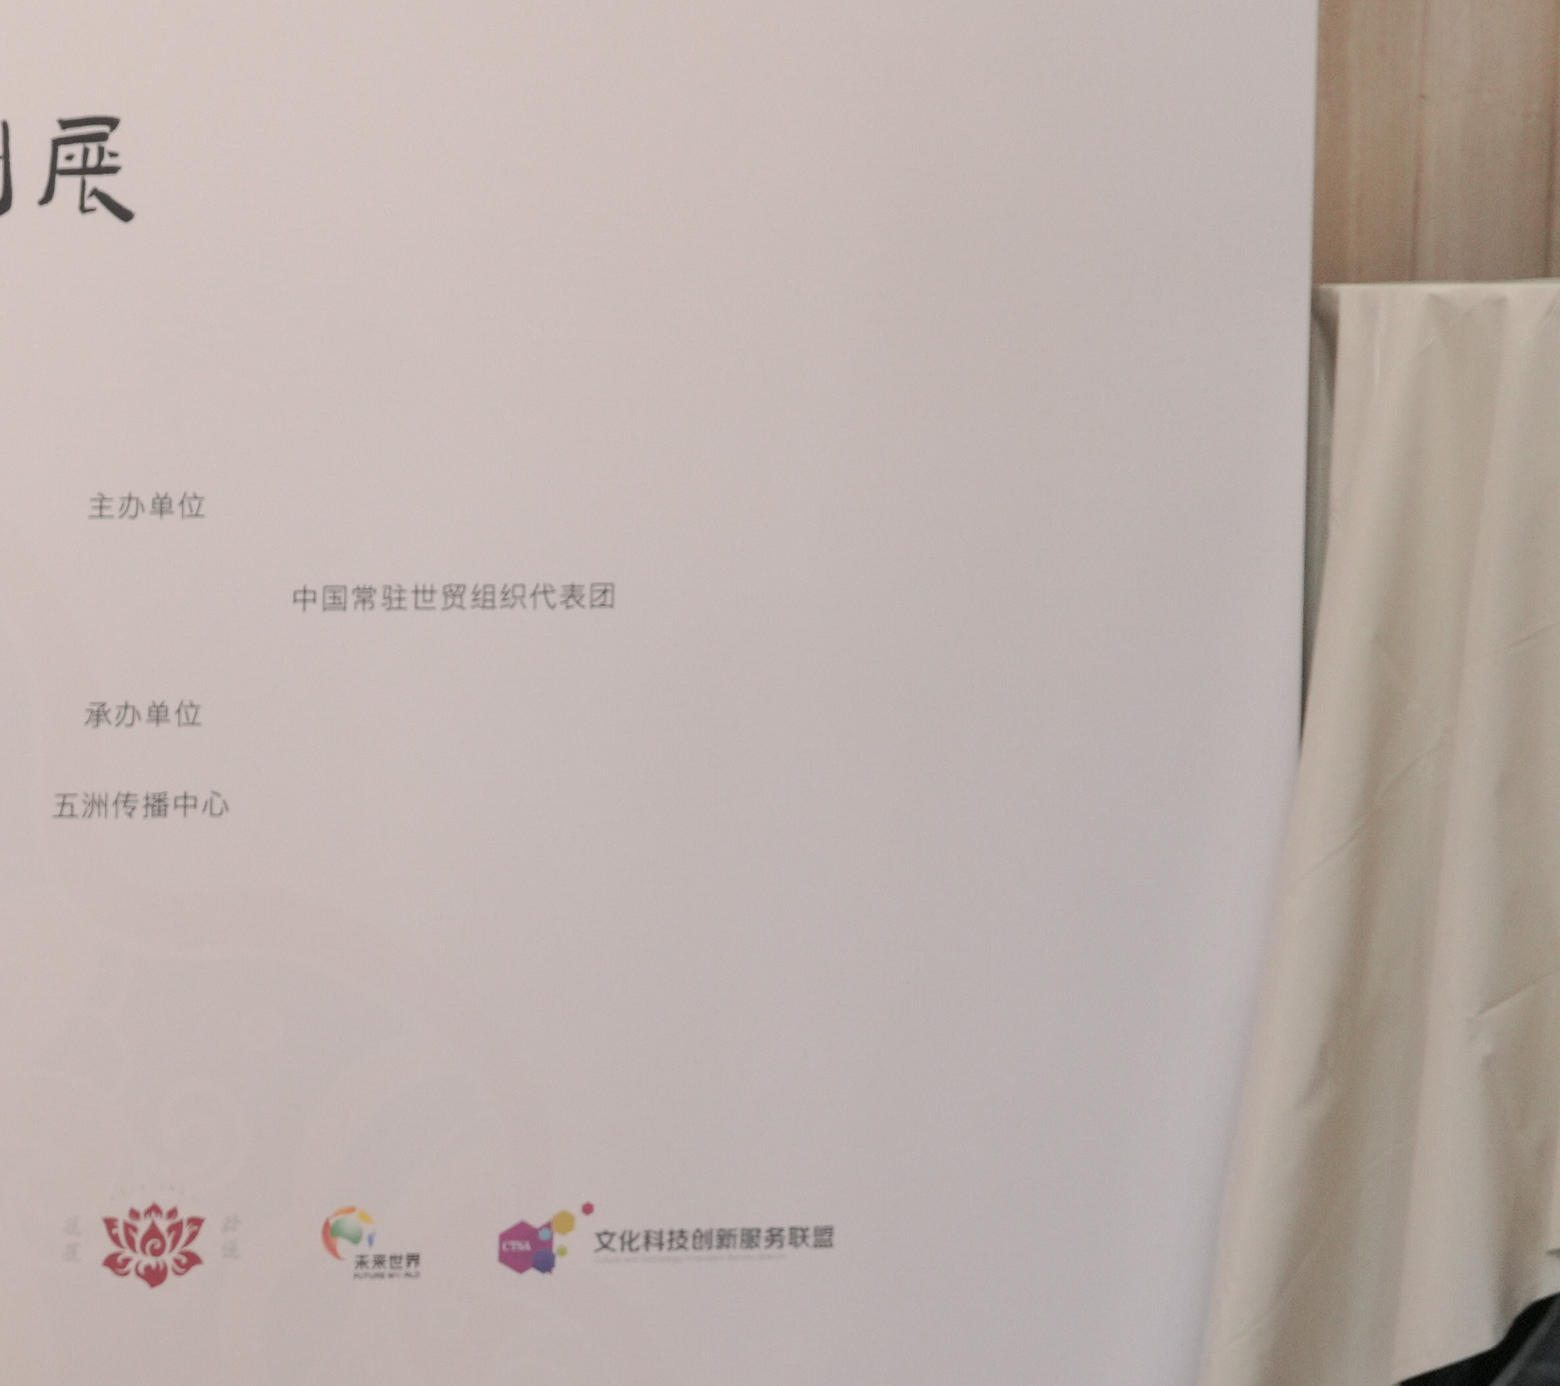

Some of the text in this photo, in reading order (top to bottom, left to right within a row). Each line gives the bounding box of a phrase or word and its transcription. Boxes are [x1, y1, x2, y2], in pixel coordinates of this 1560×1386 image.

[88, 491, 206, 521] 主办单位
[292, 581, 616, 612] 中国常驻世贸组织代表团
[84, 699, 202, 729] 承办单位
[52, 789, 230, 820] 五洲传播中心
[593, 1225, 834, 1253] 文化科技创新服务联盟
[354, 1252, 420, 1269] 未来世界
